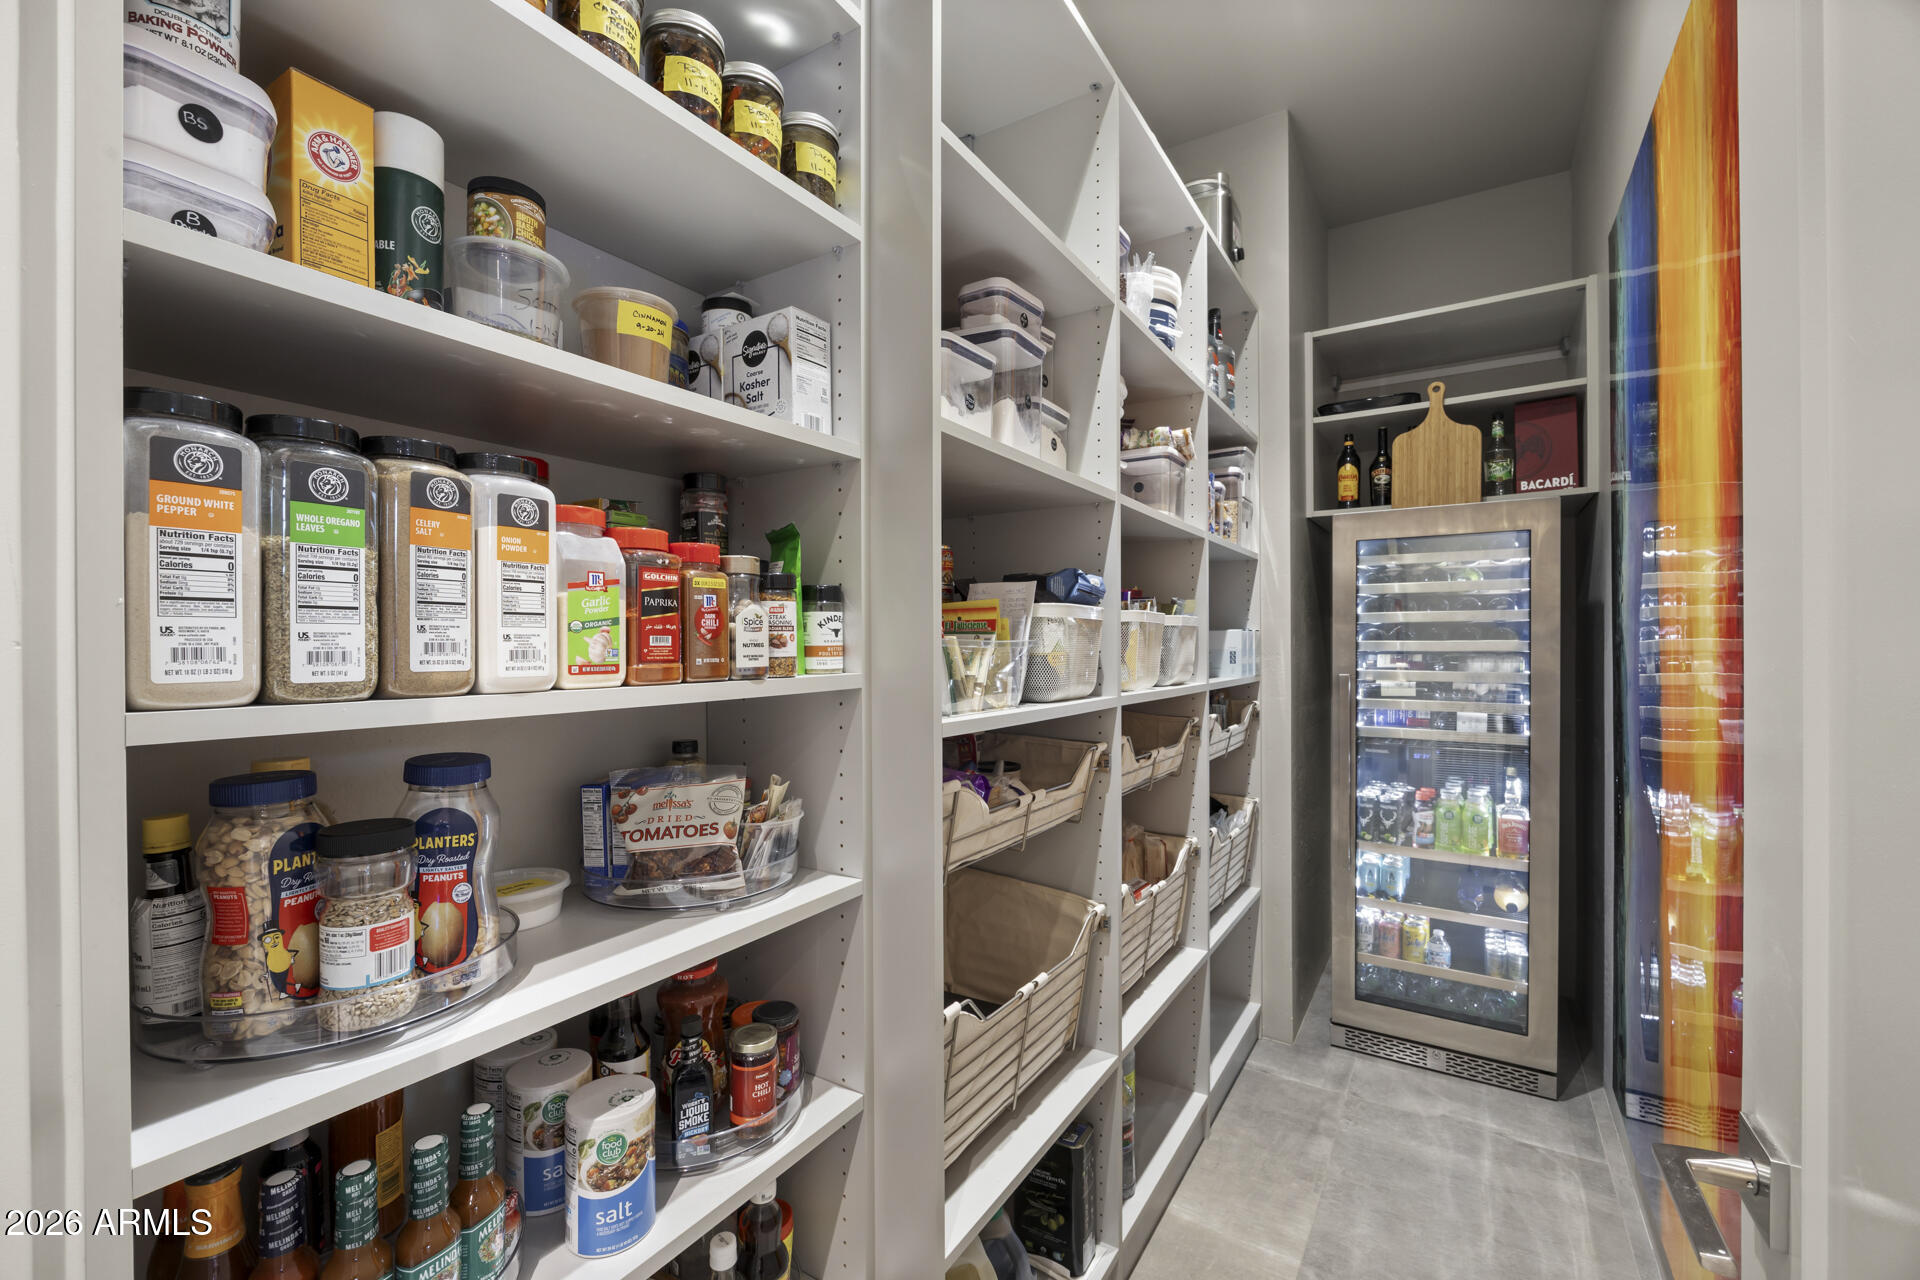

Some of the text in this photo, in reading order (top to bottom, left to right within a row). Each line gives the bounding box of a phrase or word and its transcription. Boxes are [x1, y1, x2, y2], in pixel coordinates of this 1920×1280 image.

[154, 8, 222, 43] DOUBLE ACTING
[127, 11, 237, 69] BAKING POWDER
[183, 110, 208, 130] BS
[311, 136, 322, 154] ARM
[329, 136, 358, 170] HAMMER
[302, 182, 320, 194] Drug
[321, 189, 341, 200] Facts
[186, 211, 201, 226] B
[516, 211, 538, 229] BROTH
[516, 220, 535, 233] BASE
[632, 309, 668, 328] CINNAMON
[746, 369, 764, 378] Coarse
[739, 378, 771, 393] Kosher
[746, 390, 764, 404] Salt
[180, 445, 219, 462] MONARCH
[313, 470, 345, 484] MONARCH
[156, 494, 235, 511] GROUND WHITE
[156, 504, 197, 516] PEPPER
[296, 513, 360, 528] WHOLE OREGANO
[416, 518, 440, 528] CELERY
[296, 523, 325, 533] LEAVES
[416, 528, 432, 536] SALT
[159, 530, 234, 543] Nutrition Facts
[501, 536, 521, 545] ONION
[297, 546, 335, 555] Nutrition
[417, 547, 447, 555] Nutrition
[501, 544, 527, 552] POWDER
[159, 560, 234, 571] Calories 0
[502, 562, 529, 570] Nutrition
[297, 572, 359, 582] Calories 0
[644, 573, 679, 581] GOLCHIN
[581, 595, 611, 608] Garlic
[644, 596, 678, 607] PAPRIKA
[584, 606, 609, 615] Powder
[584, 619, 612, 629] ORGANIC
[701, 619, 719, 627] CHILI
[743, 617, 764, 626] Spice
[647, 815, 694, 825] DRIED
[621, 822, 720, 843] TOMATOES
[418, 851, 471, 866] Dry Roasted
[280, 877, 302, 890] Dry
[422, 872, 464, 882] PEANUTS
[152, 899, 186, 910] Nutrition
[151, 919, 184, 929] Calories
[752, 1086, 771, 1098] CHILI
[754, 1081, 769, 1091] HOT
[680, 1102, 709, 1119] LIQUID
[679, 1112, 710, 1130] SMOKE
[601, 1137, 623, 1150] food
[413, 1151, 442, 1165] MELINDA'S
[602, 1147, 622, 1160] club
[270, 1174, 302, 1196] MELINDA'S
[413, 1174, 442, 1190] MELINDA'S
[345, 1183, 362, 1195] MELI
[265, 1203, 299, 1222] MELINDA'S
[345, 1208, 362, 1219] MELI
[412, 1199, 443, 1216] MELINDA'S
[595, 1200, 632, 1225] salt
[268, 1227, 303, 1249] MELINDA'S
